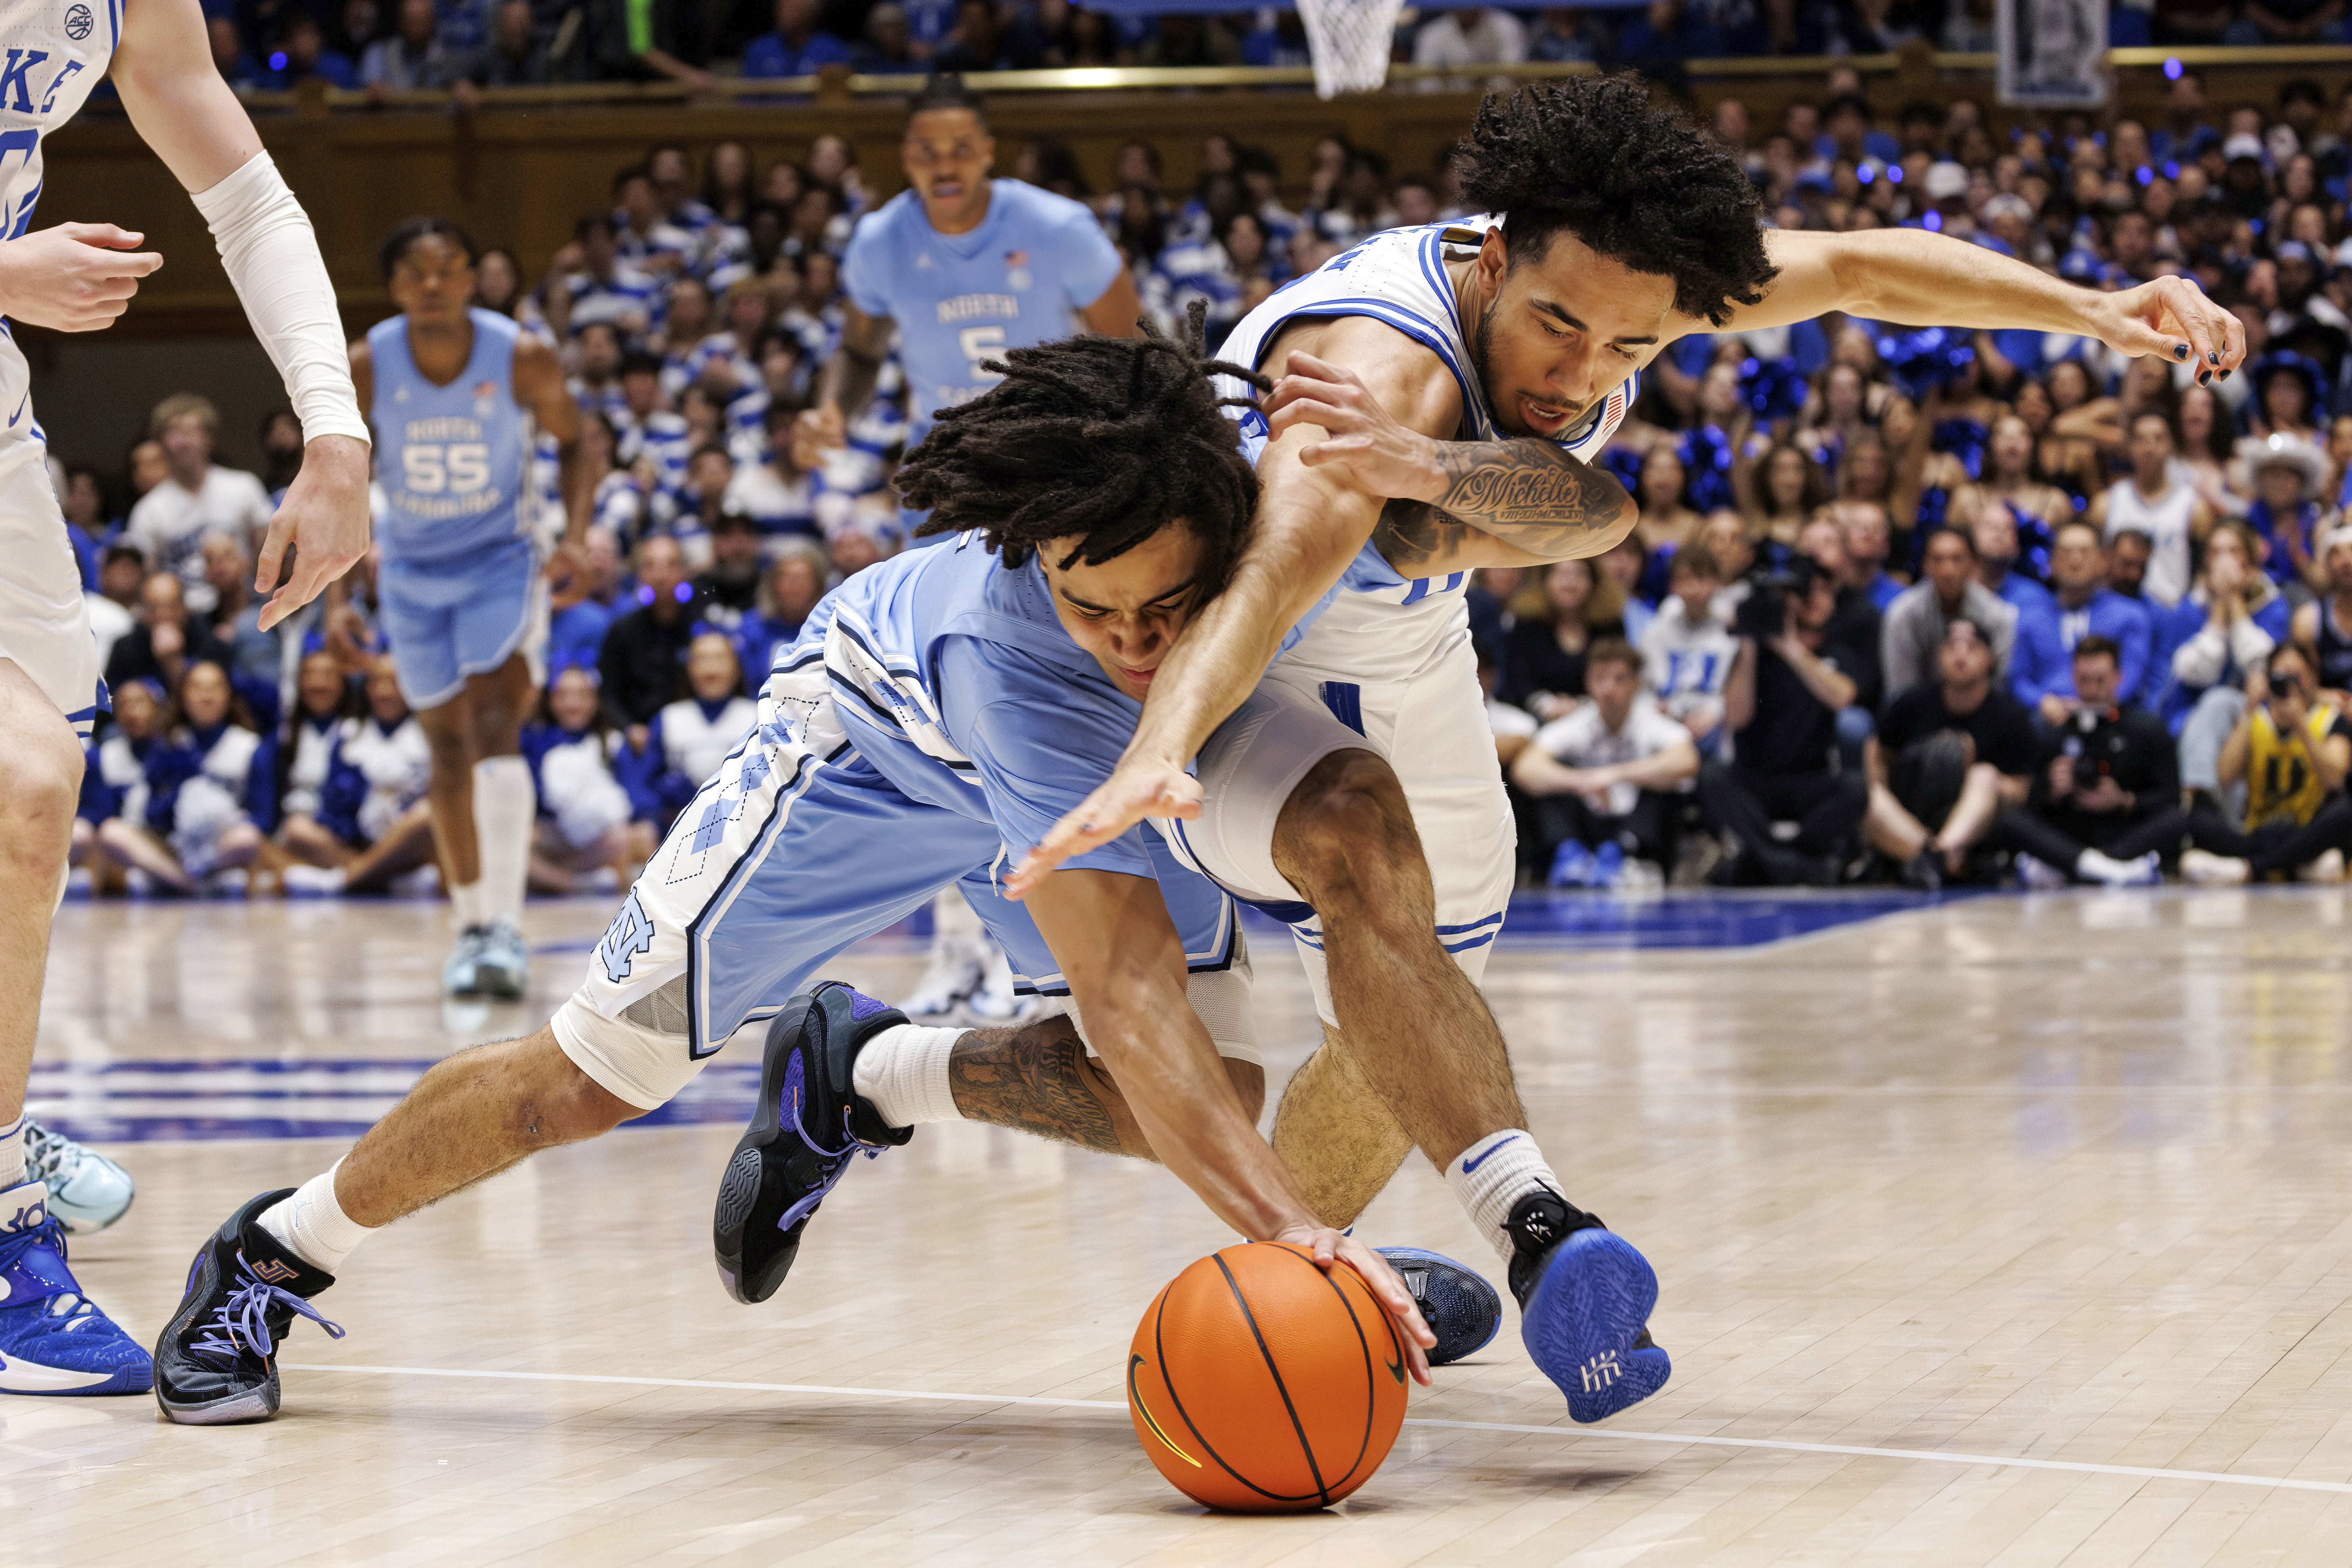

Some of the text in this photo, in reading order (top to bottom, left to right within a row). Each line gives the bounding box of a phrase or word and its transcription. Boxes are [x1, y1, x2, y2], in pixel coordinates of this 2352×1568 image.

[69, 15, 92, 24] ACC
[960, 325, 1011, 381] 5
[402, 444, 489, 492] 55
[1449, 466, 1575, 514] Michelle
